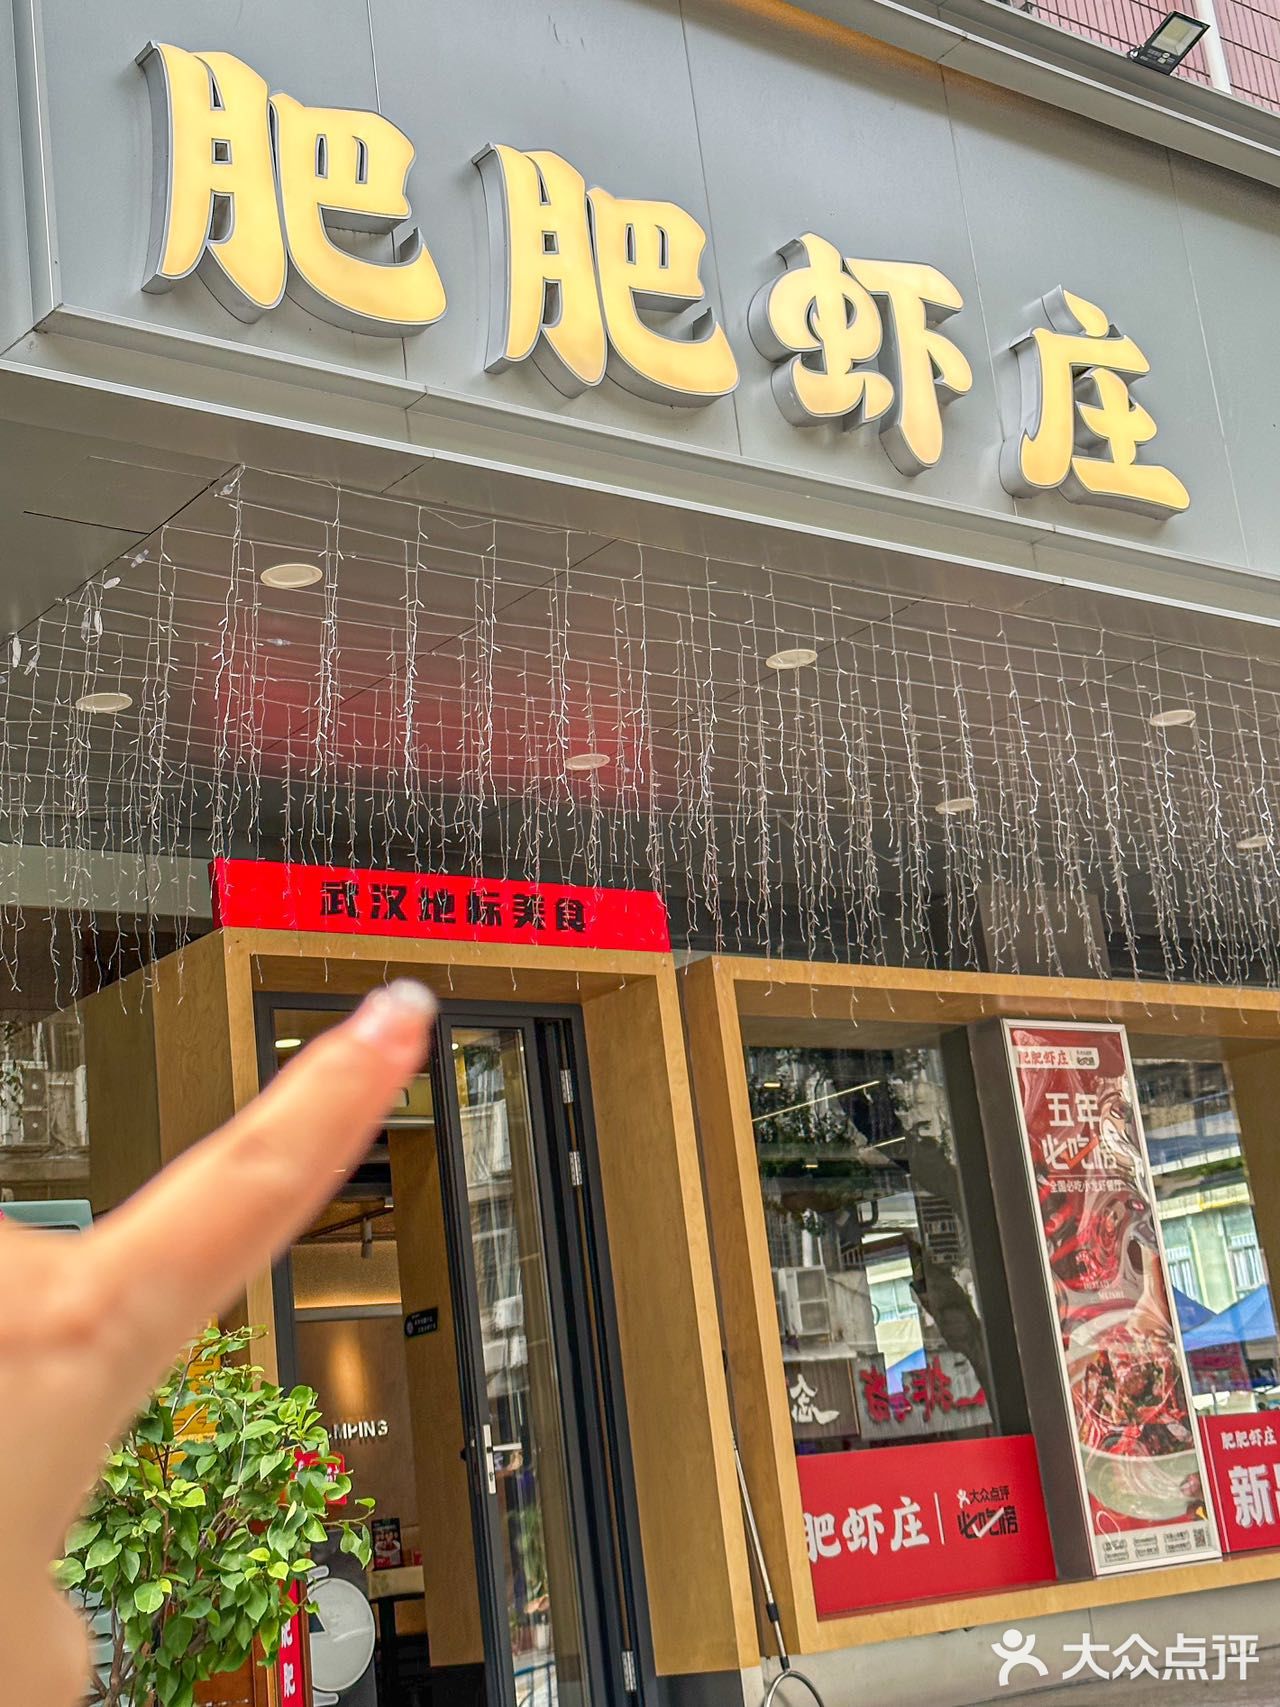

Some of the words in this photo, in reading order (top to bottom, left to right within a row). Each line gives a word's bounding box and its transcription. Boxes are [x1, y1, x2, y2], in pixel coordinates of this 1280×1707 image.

[142, 41, 1191, 514] 肥肥虾庄
[320, 880, 587, 932] 武汉地标美食
[1045, 1093, 1100, 1130] 五年
[328, 1420, 388, 1440] MPING
[1220, 1425, 1277, 1450] 肥肥虾庄
[969, 1485, 1010, 1503] 大众点评
[957, 1505, 1019, 1540] 必吃榜
